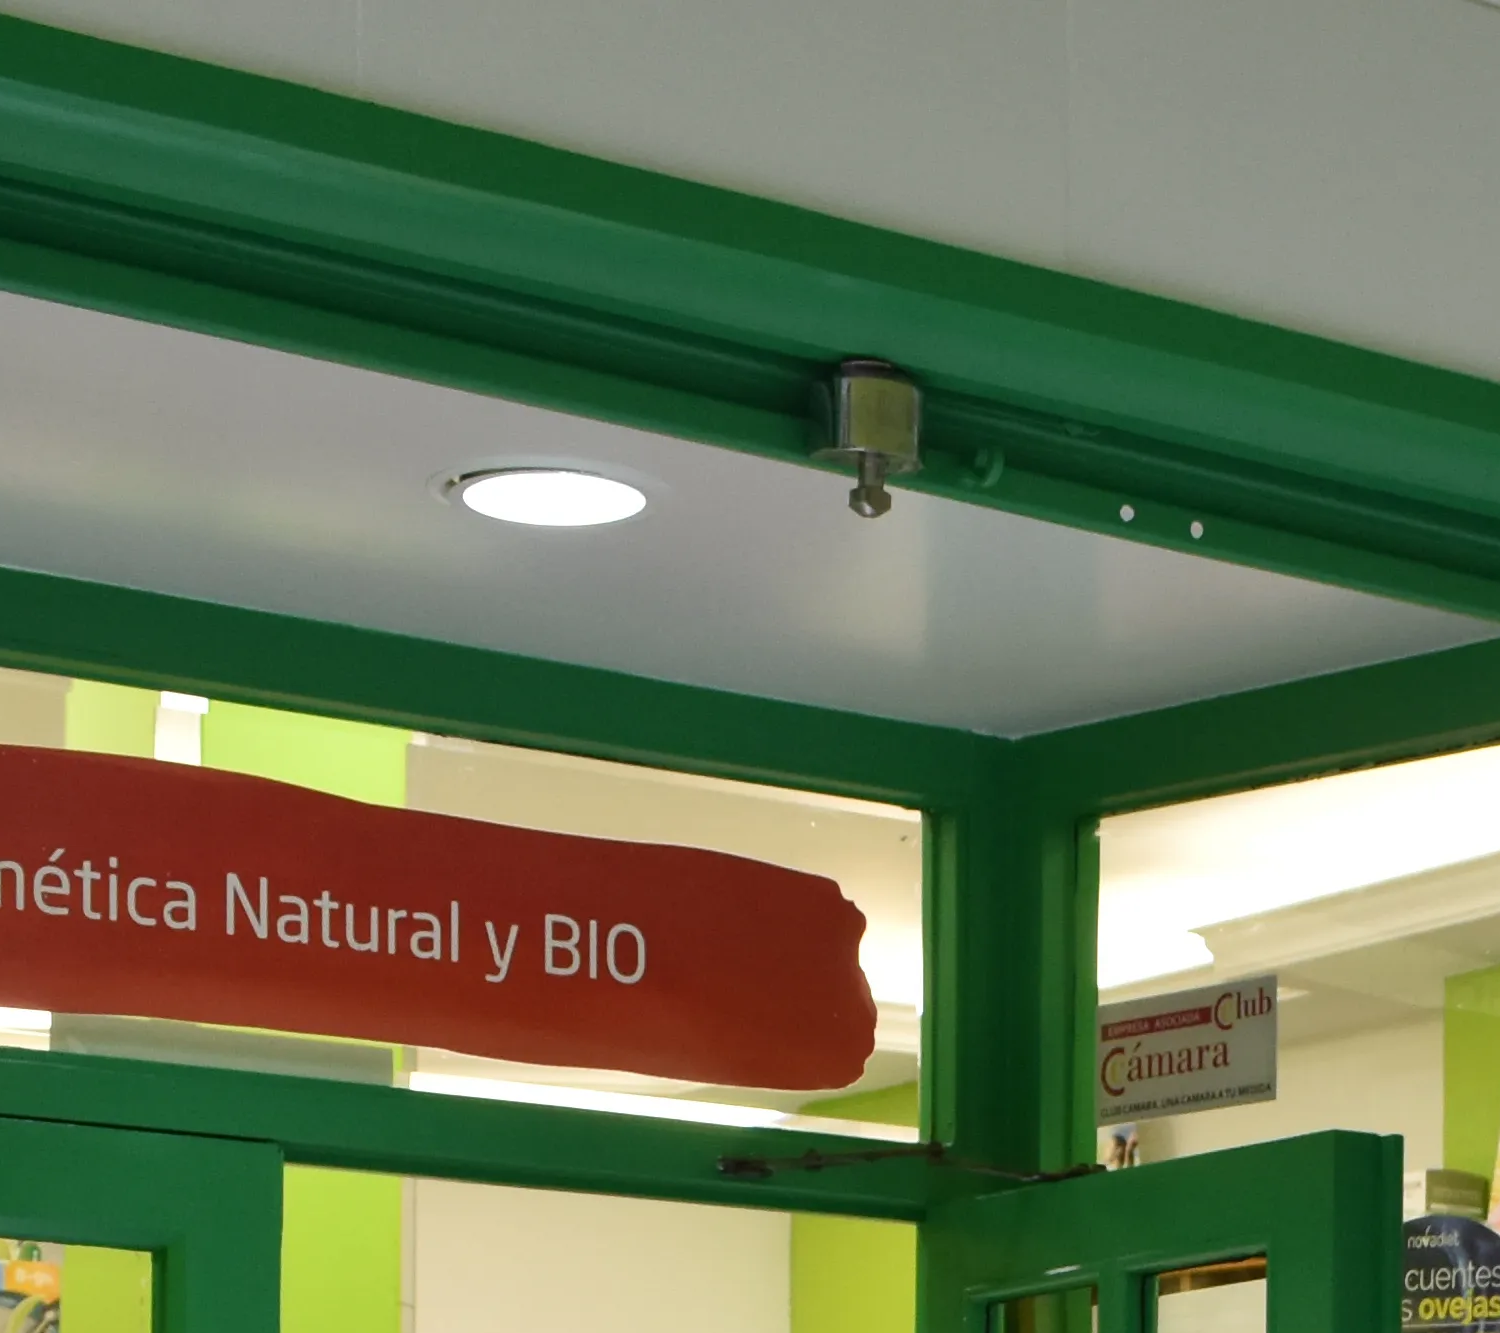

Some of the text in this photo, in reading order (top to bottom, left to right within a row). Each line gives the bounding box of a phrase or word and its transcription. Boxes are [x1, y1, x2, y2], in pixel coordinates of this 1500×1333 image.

[225, 873, 461, 963] Natural
[484, 922, 518, 983] y
[542, 914, 647, 985] BIO
[1213, 987, 1273, 1031] Club
[1100, 1040, 1230, 1098] Cámara
